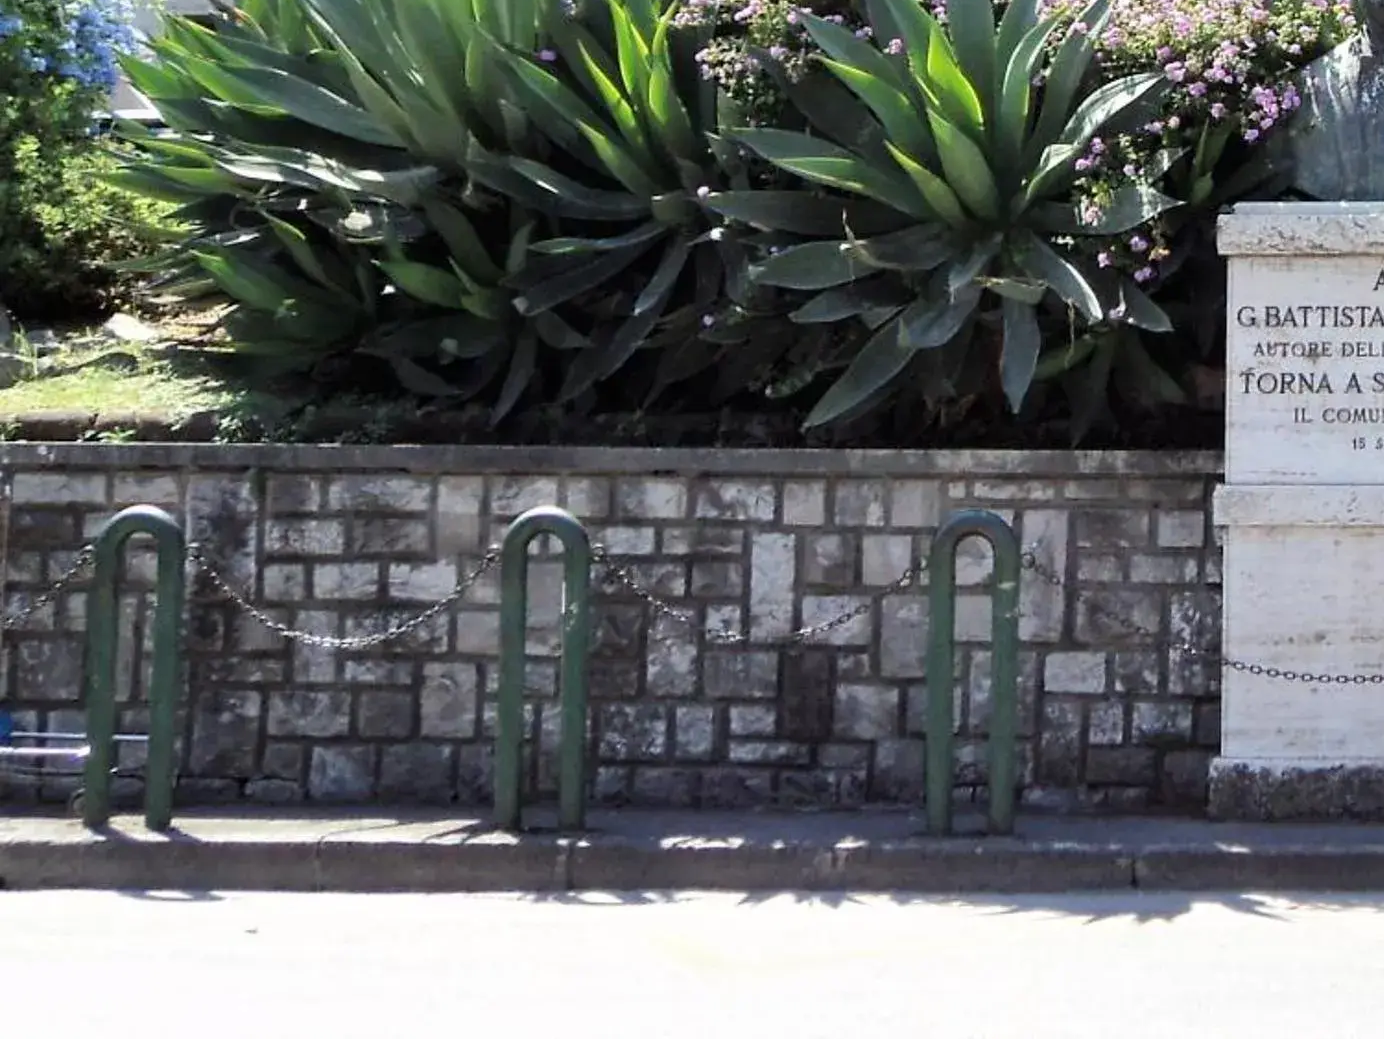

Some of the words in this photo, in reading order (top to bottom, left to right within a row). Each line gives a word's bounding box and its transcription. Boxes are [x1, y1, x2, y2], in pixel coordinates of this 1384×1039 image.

[1254, 342, 1333, 358] AUTORE
[1239, 368, 1332, 395] TORNA
[1345, 372, 1363, 394] A
[1293, 408, 1313, 424] IL
[1351, 438, 1366, 450] 15
